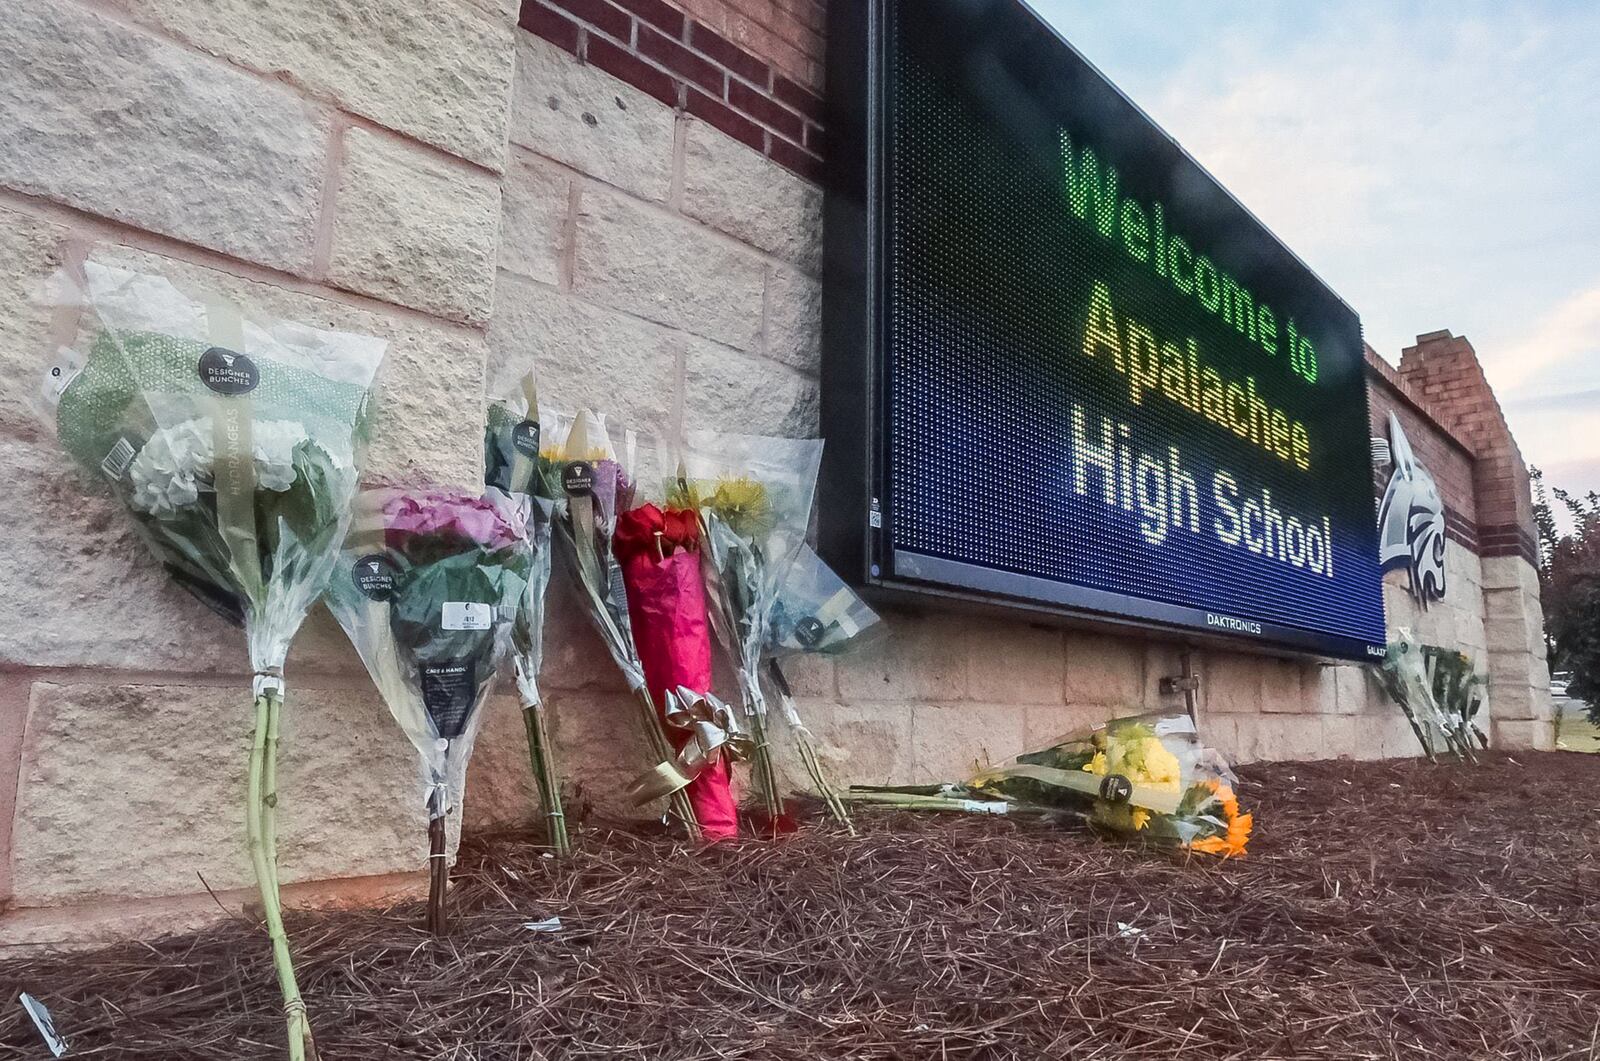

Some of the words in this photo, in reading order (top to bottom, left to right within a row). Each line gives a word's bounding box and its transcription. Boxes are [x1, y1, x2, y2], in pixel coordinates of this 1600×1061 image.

[1057, 125, 1277, 358] Welcome
[1286, 317, 1319, 384] to
[208, 367, 250, 379] DESIGNER
[209, 376, 250, 386] BUNCHES
[1082, 279, 1310, 472] Apalachee
[1071, 403, 1200, 546] High
[1212, 468, 1334, 578] School
[1207, 613, 1262, 635] DAKTRONICS
